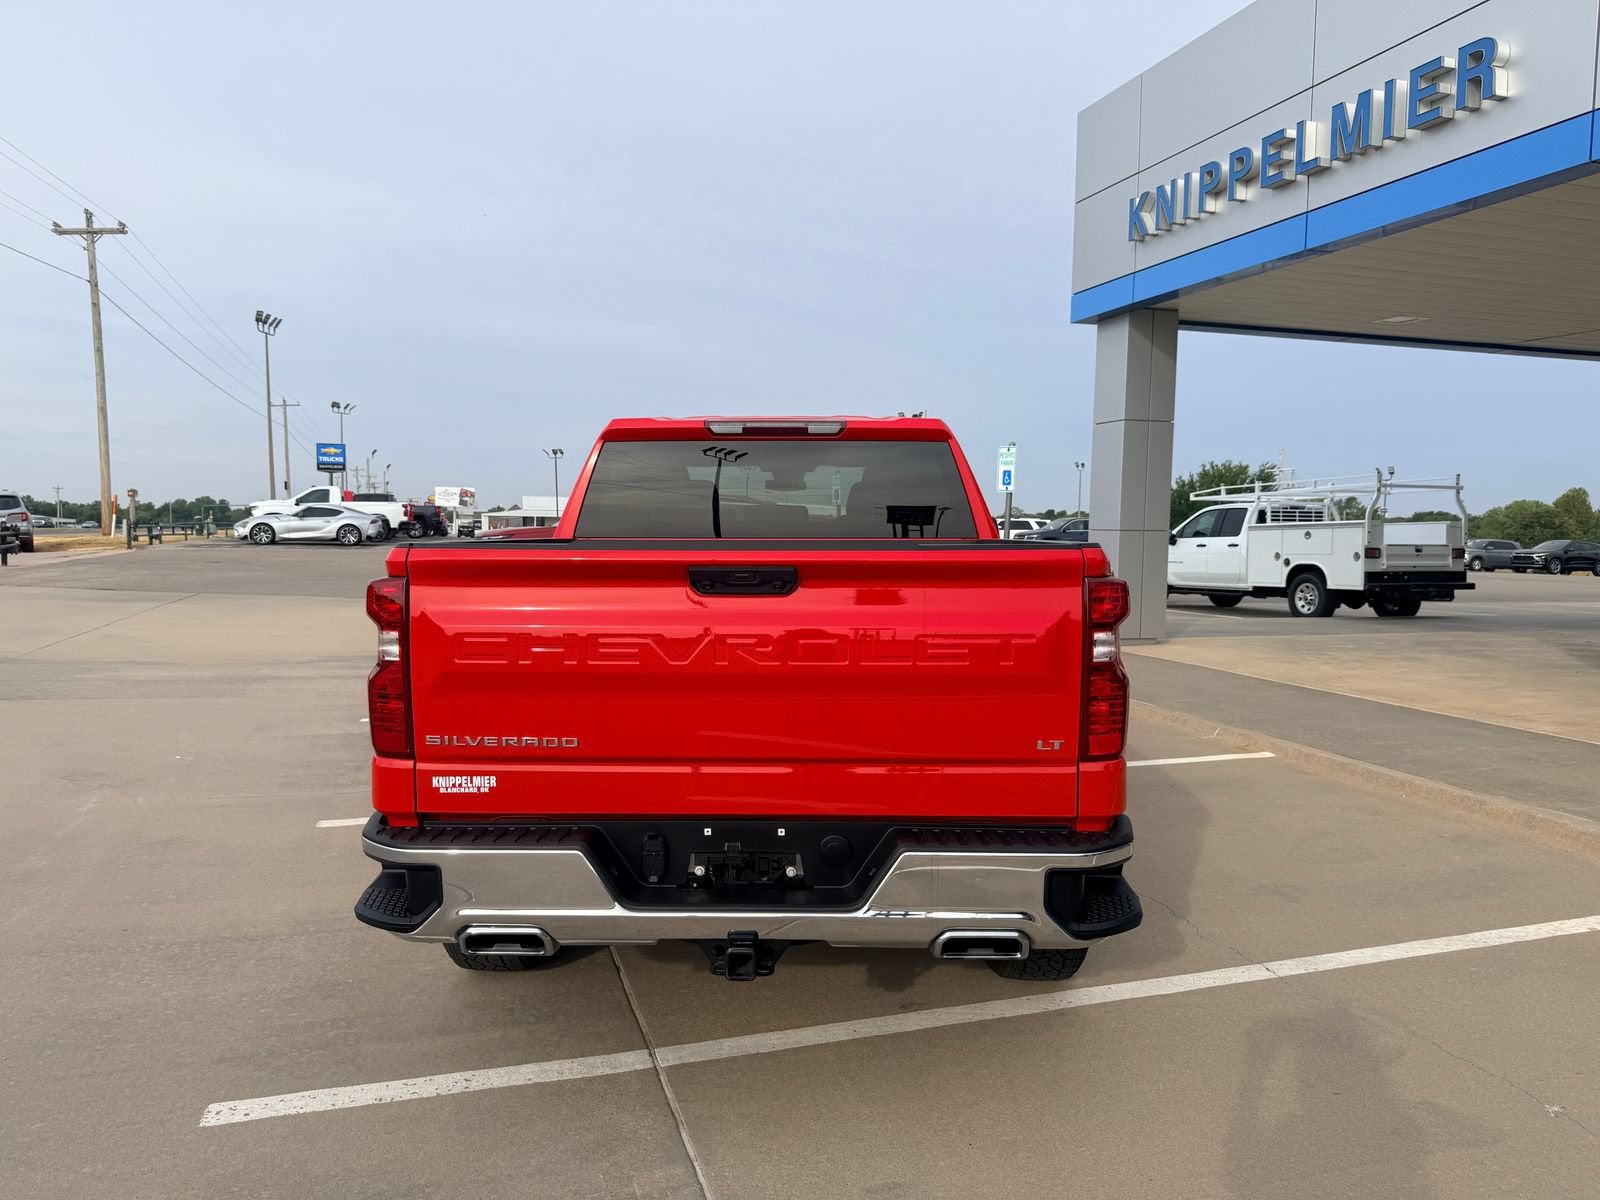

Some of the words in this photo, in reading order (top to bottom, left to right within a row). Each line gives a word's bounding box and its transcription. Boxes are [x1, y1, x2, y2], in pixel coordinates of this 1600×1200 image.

[1128, 37, 1509, 242] KNIPPELMIER
[453, 633, 1037, 665] CHEVROLET
[425, 735, 579, 747] SILVERADO
[1036, 740, 1065, 750] LT
[432, 776, 497, 787] KNIPPELMIER
